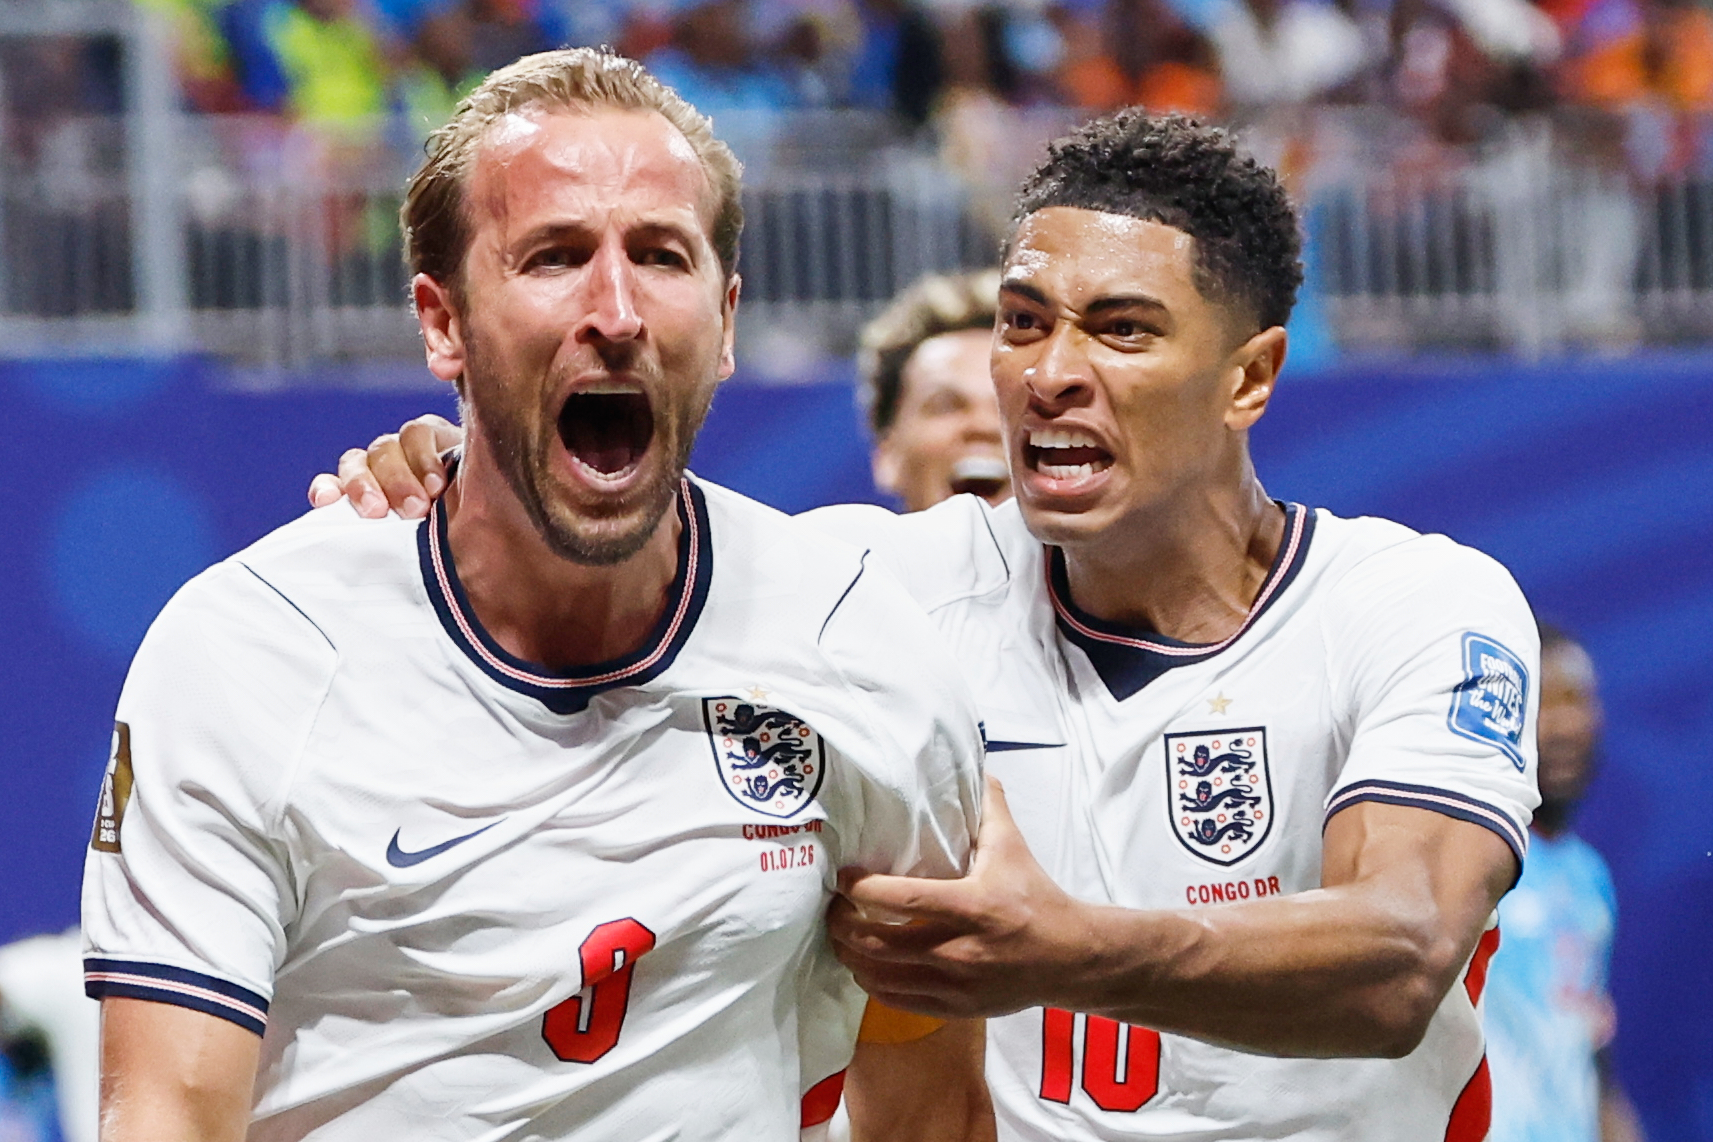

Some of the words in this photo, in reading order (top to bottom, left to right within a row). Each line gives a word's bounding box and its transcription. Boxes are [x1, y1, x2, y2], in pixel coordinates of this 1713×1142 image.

[99, 828, 116, 843] 26
[760, 844, 814, 872] 01.07.26
[1186, 881, 1250, 904] CONGO
[1254, 875, 1281, 898] DR
